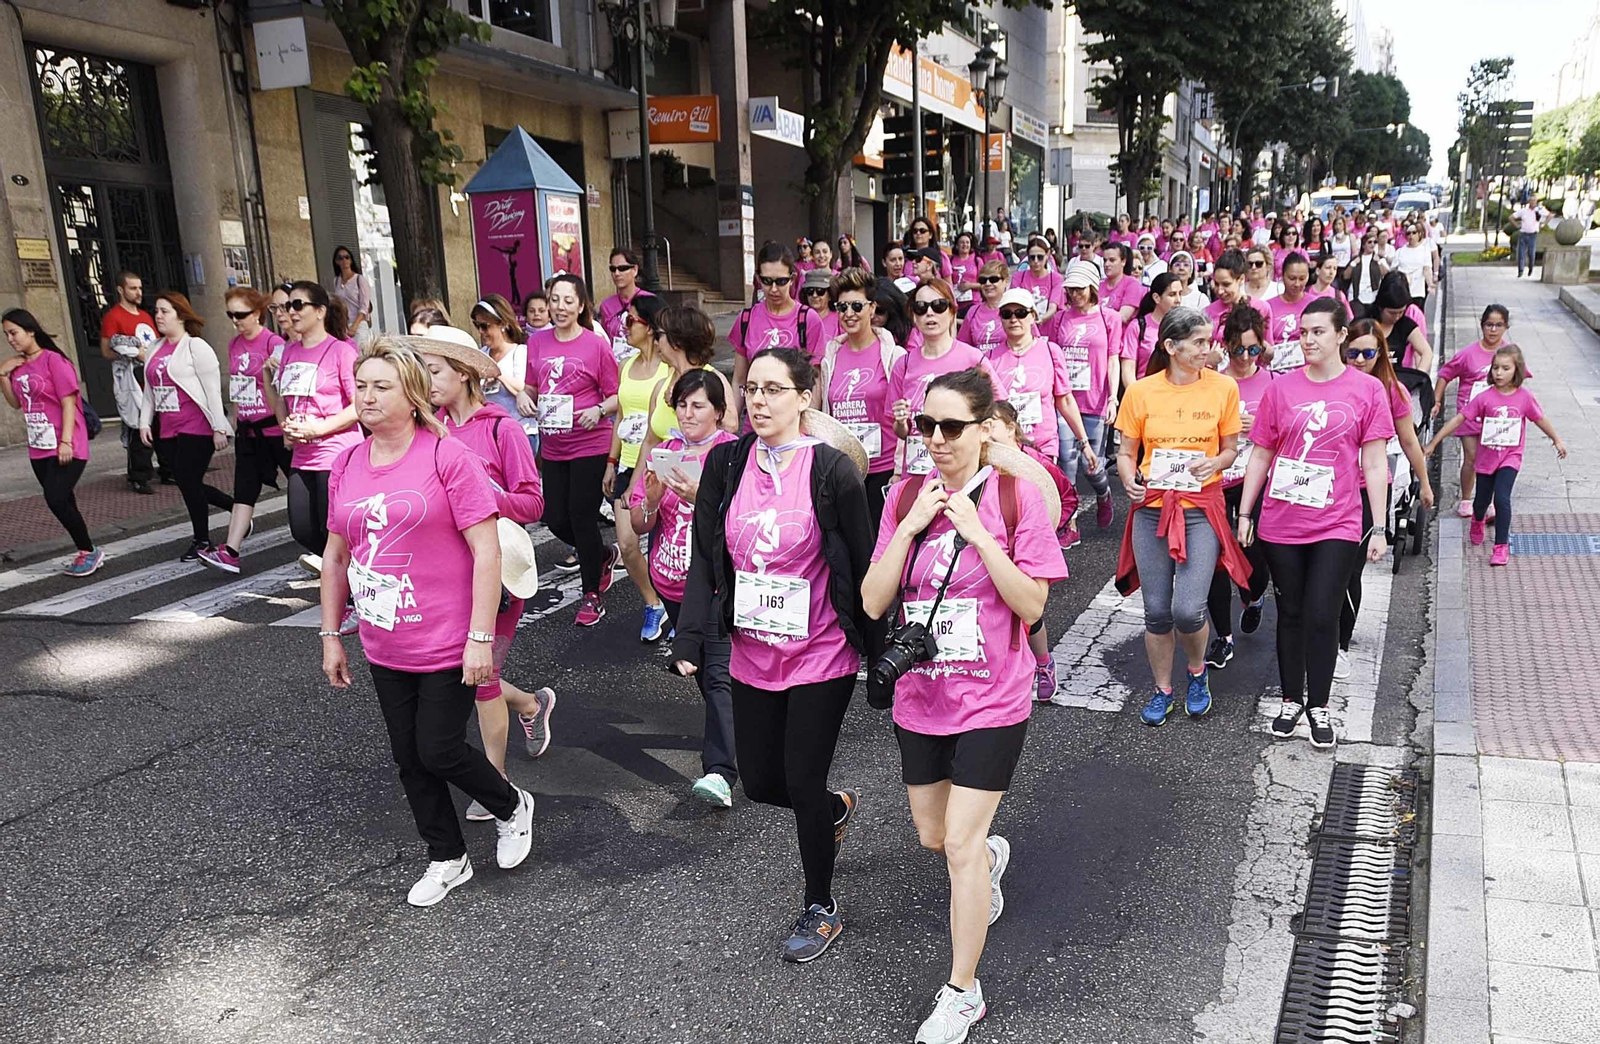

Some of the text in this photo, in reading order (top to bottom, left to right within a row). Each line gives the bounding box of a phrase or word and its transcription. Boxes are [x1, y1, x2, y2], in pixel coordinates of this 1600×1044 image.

[649, 106, 712, 125] Ramiro Gill
[778, 113, 803, 142] ABAN
[483, 195, 519, 218] Dirty
[489, 209, 525, 232] Dancing
[832, 400, 867, 411] CARRERA
[833, 408, 868, 418] FEMENINA
[1169, 462, 1186, 474] 903
[1292, 474, 1310, 487] 904
[660, 533, 691, 562] CARRE
[358, 582, 376, 601] 1179
[759, 593, 785, 609] 1163
[402, 614, 423, 623] VIGO
[970, 669, 991, 678] VIGO
